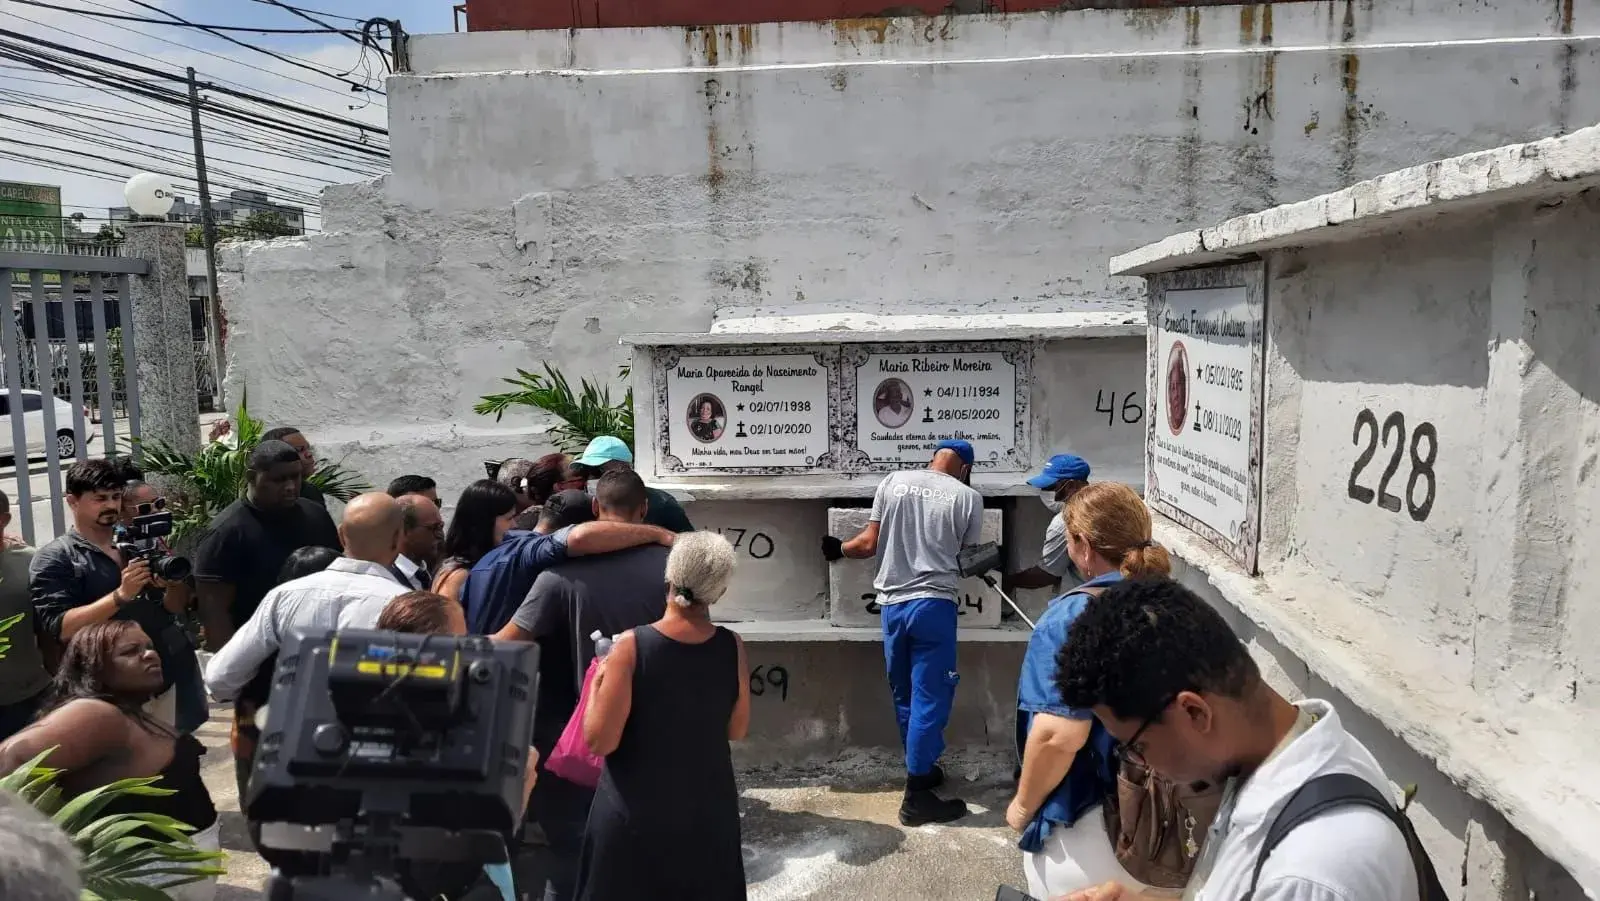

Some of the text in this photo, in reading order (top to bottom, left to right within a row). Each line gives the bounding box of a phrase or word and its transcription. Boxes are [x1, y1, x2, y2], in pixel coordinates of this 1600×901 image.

[879, 358, 993, 373] Maria Ribeiro Moreira
[677, 366, 704, 380] Maria
[706, 366, 751, 382] Aparecida
[766, 365, 817, 378] Nascimento
[731, 380, 764, 396] Rangel
[936, 386, 1000, 398] 04/11/1934
[749, 401, 812, 413] 02/07/1938
[936, 408, 1000, 420] 28/05/2020
[1094, 389, 1143, 427] 46
[749, 423, 812, 435] 02/10/2020
[1203, 409, 1242, 442] 08/11/2023
[870, 431, 904, 441] Saudades
[928, 431, 937, 441] de
[1349, 408, 1438, 523] 228
